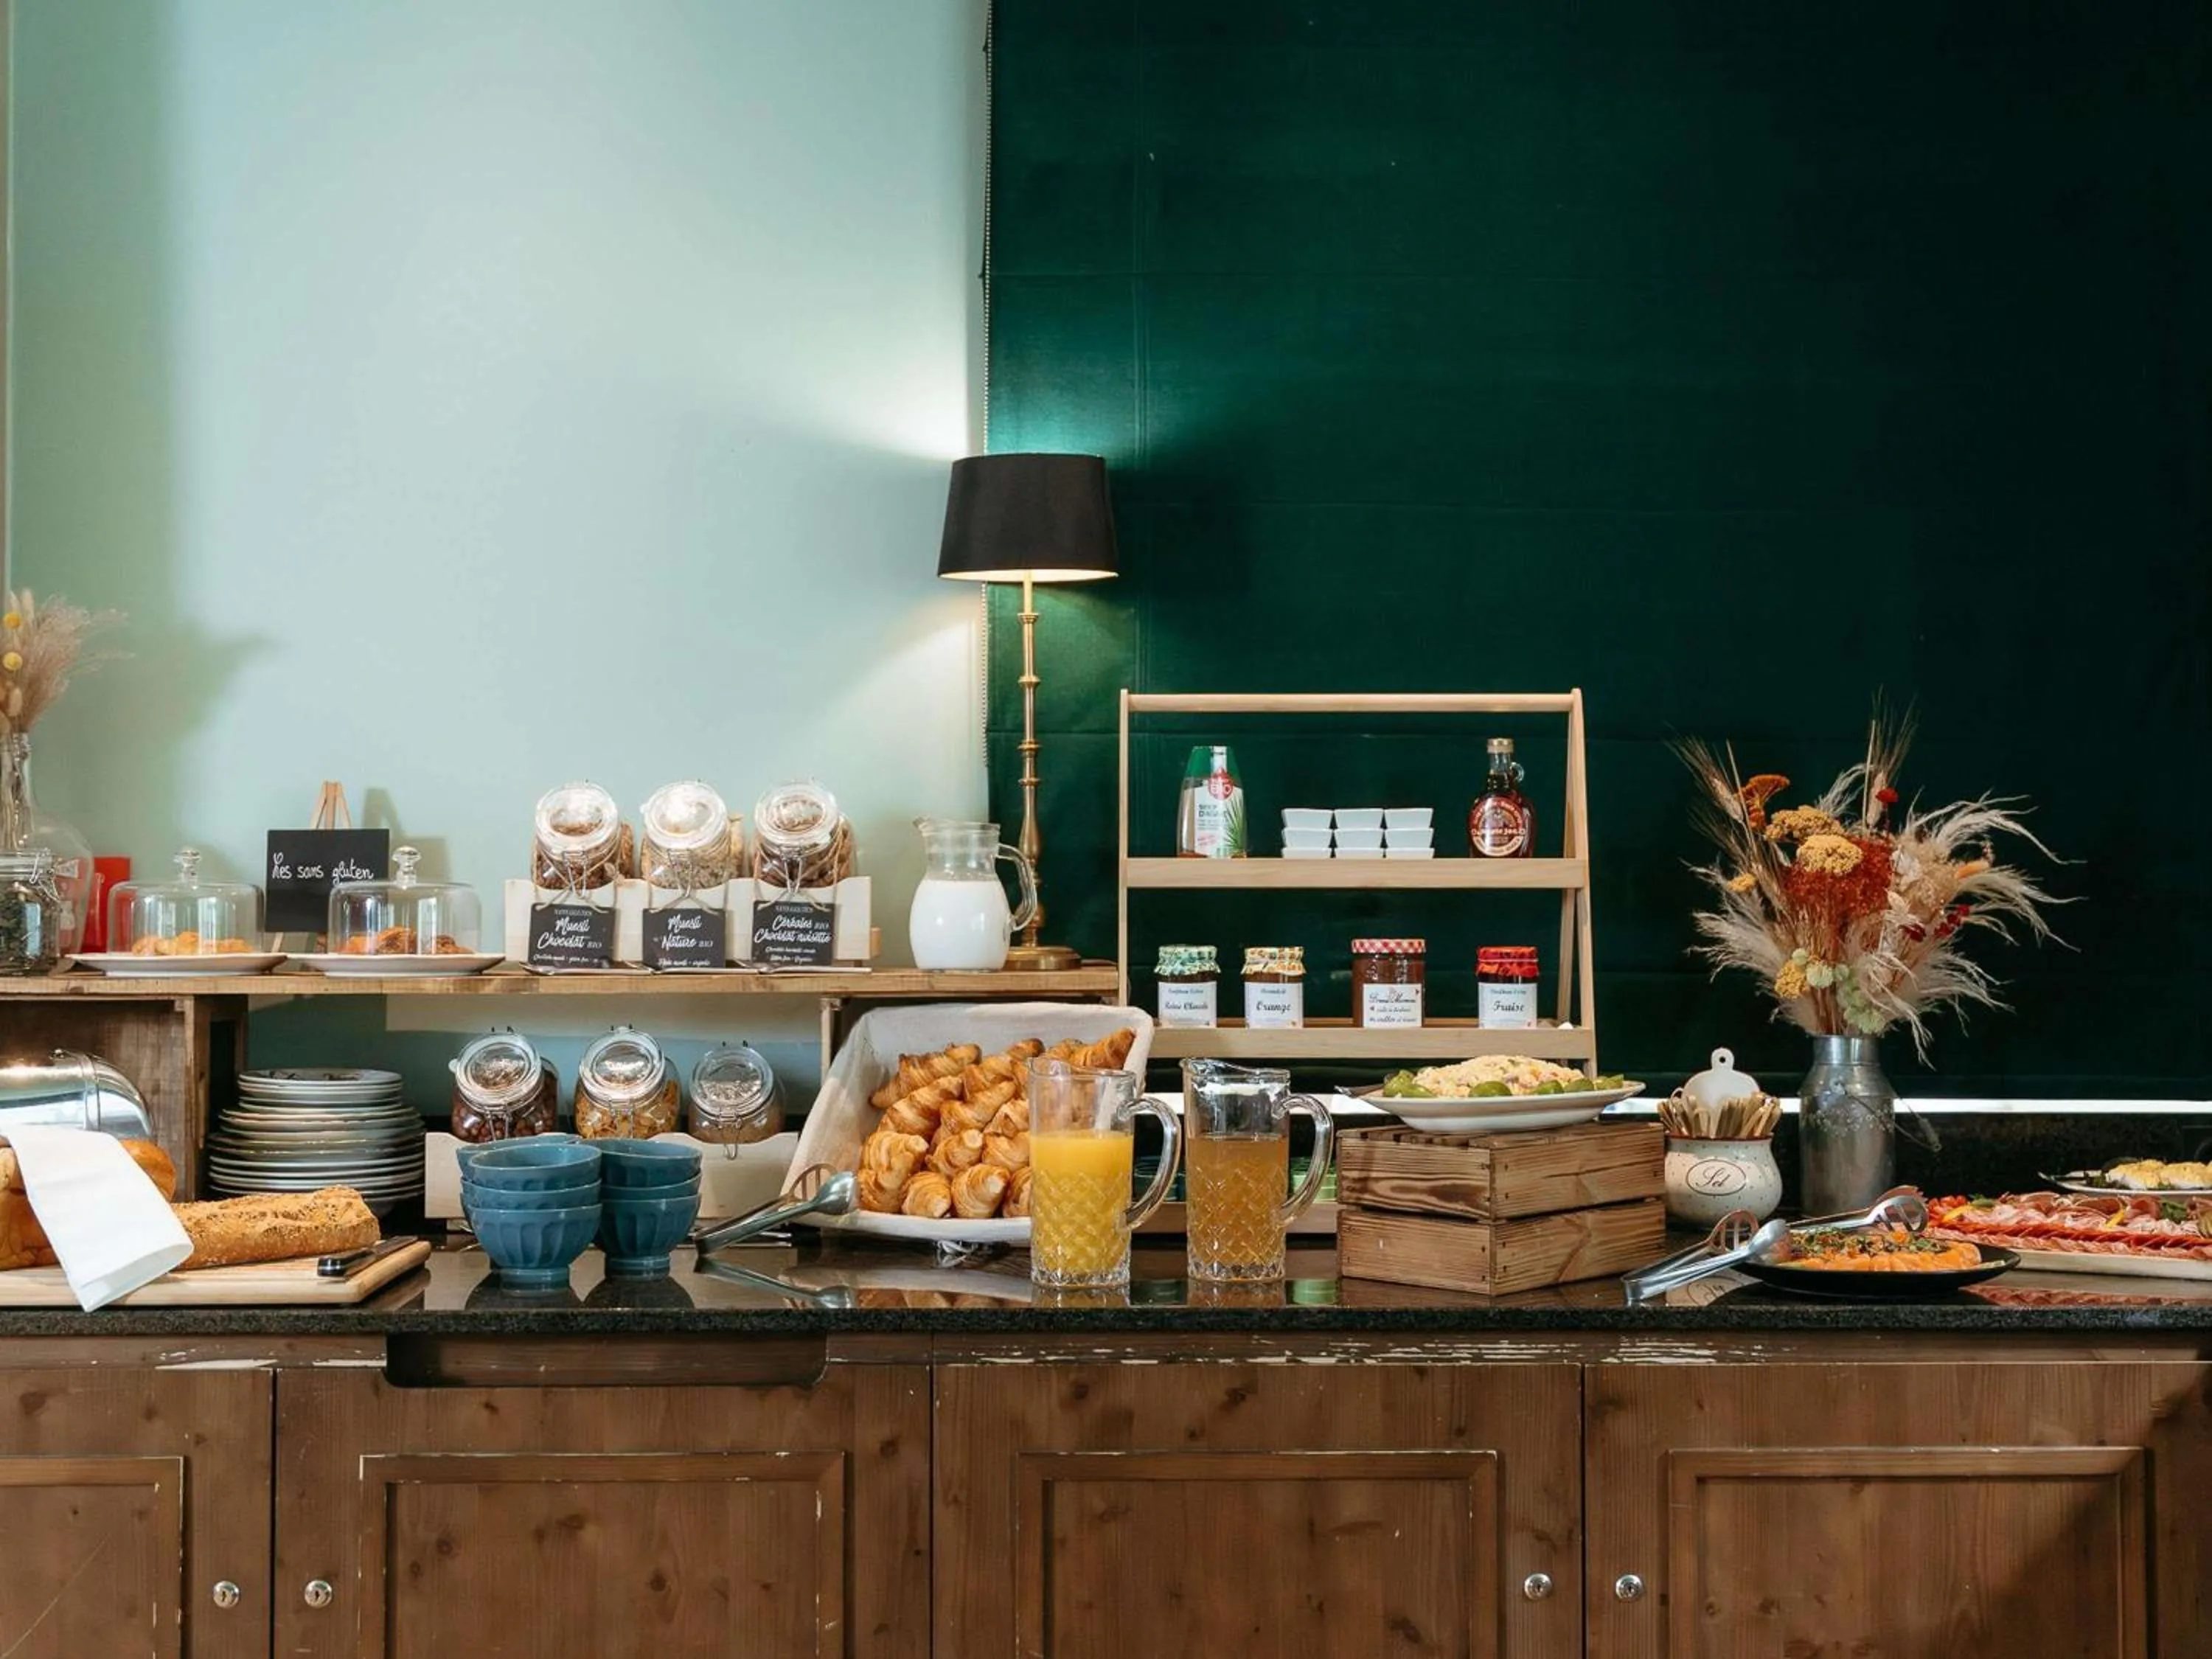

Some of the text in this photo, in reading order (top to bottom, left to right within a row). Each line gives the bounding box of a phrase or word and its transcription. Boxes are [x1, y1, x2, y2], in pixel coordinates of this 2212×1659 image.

[296, 864, 325, 879] sans
[332, 858, 374, 886] gluten
[554, 916, 591, 936] Muesli
[667, 914, 703, 933] Muesli
[661, 933, 697, 951] Nature
[1256, 1001, 1291, 1015] Orange
[1493, 1000, 1525, 1012] Fraise
[1694, 1166, 1731, 1188] Sel
